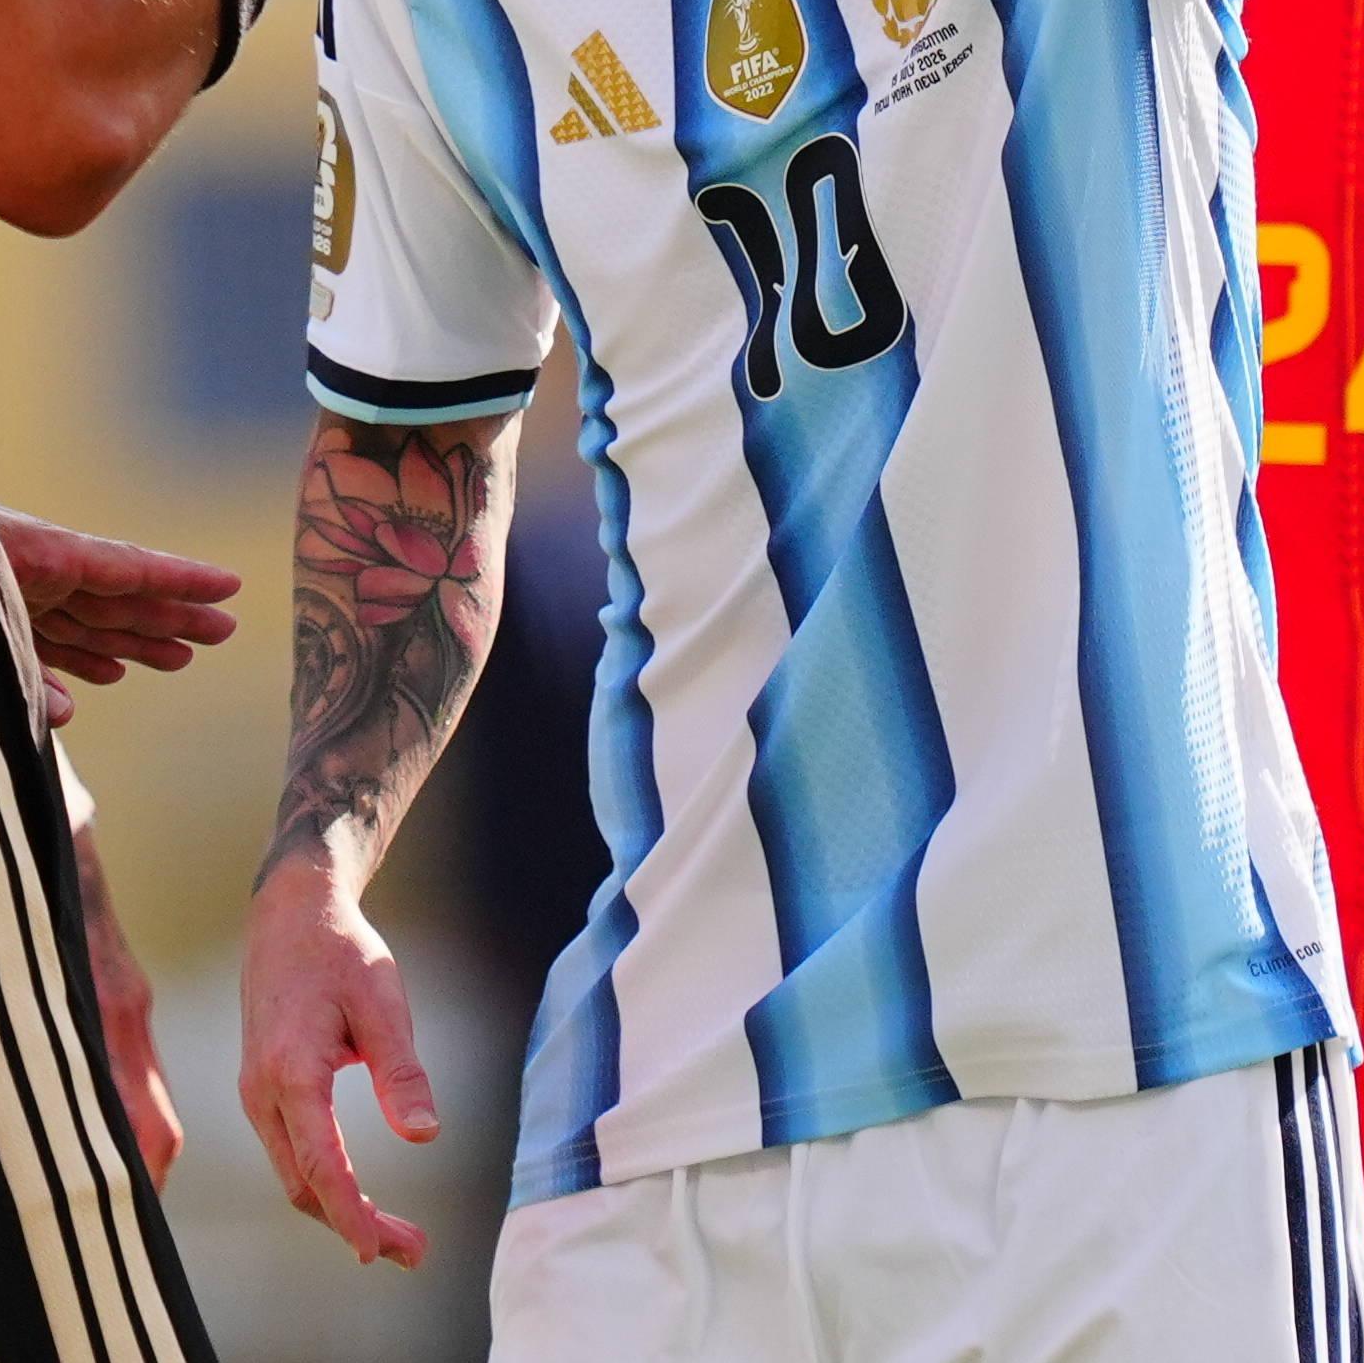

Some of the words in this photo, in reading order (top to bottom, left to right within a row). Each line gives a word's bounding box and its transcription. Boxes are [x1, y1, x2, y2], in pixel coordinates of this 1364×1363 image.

[730, 49, 780, 84] FIFA
[891, 83, 914, 105] YORK
[914, 71, 941, 93] NEW
[942, 43, 974, 78] JERSEY
[899, 62, 915, 82] JULY
[917, 48, 947, 72] 2026
[744, 82, 775, 103] 2022
[695, 132, 907, 402] 10
